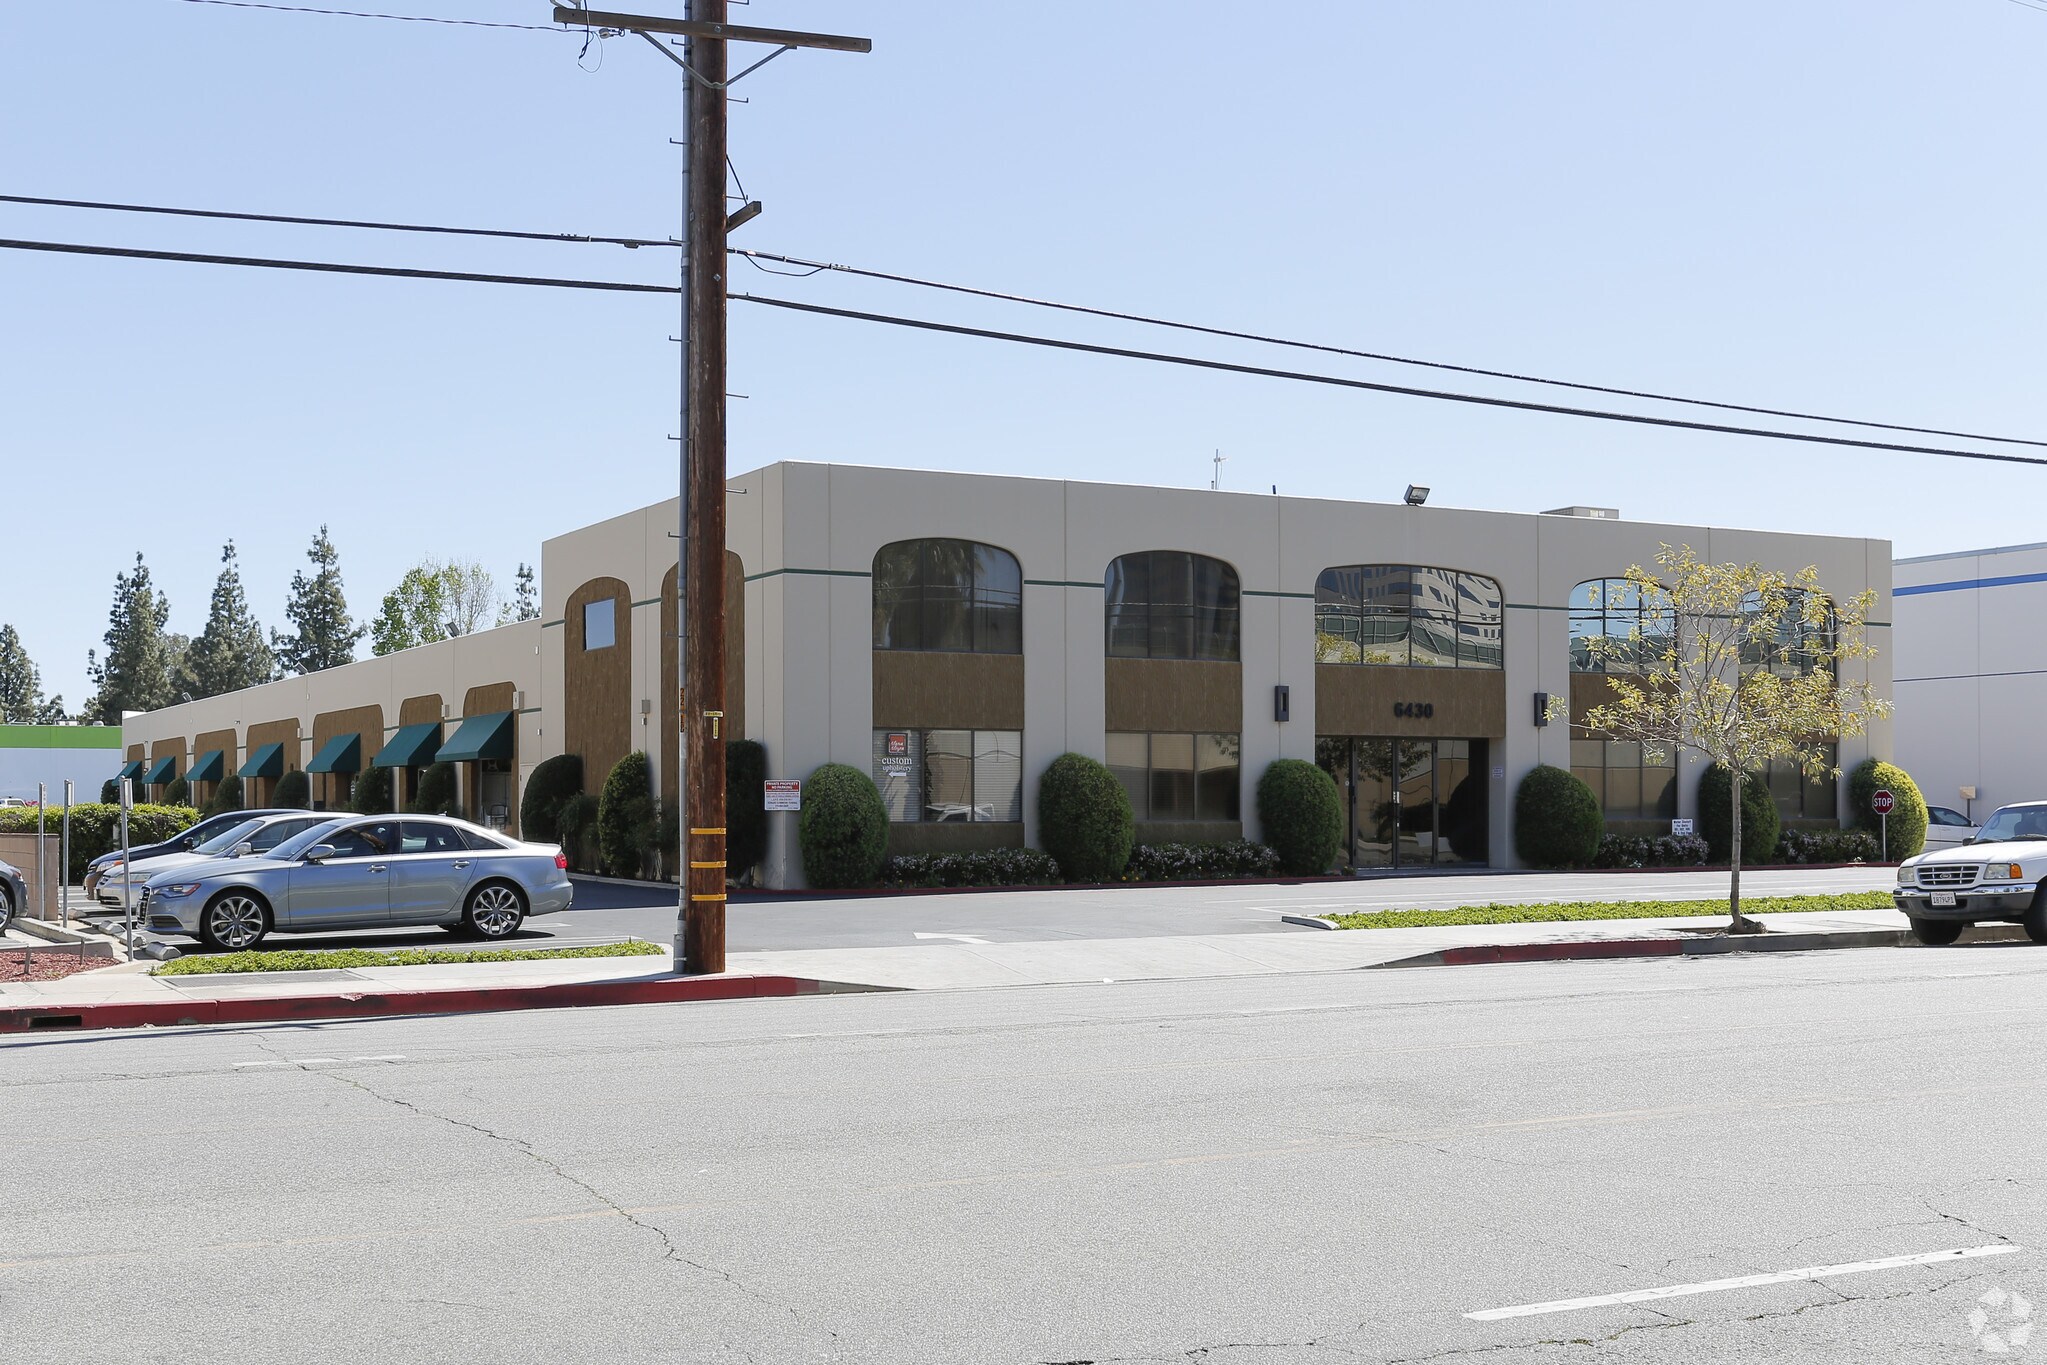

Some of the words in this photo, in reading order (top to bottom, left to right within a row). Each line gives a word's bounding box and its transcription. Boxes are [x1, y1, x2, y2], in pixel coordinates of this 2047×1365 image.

[1393, 702, 1434, 719] 6430
[881, 757, 912, 765] custom
[882, 765, 911, 773] upholstery
[1874, 797, 1892, 807] STOP
